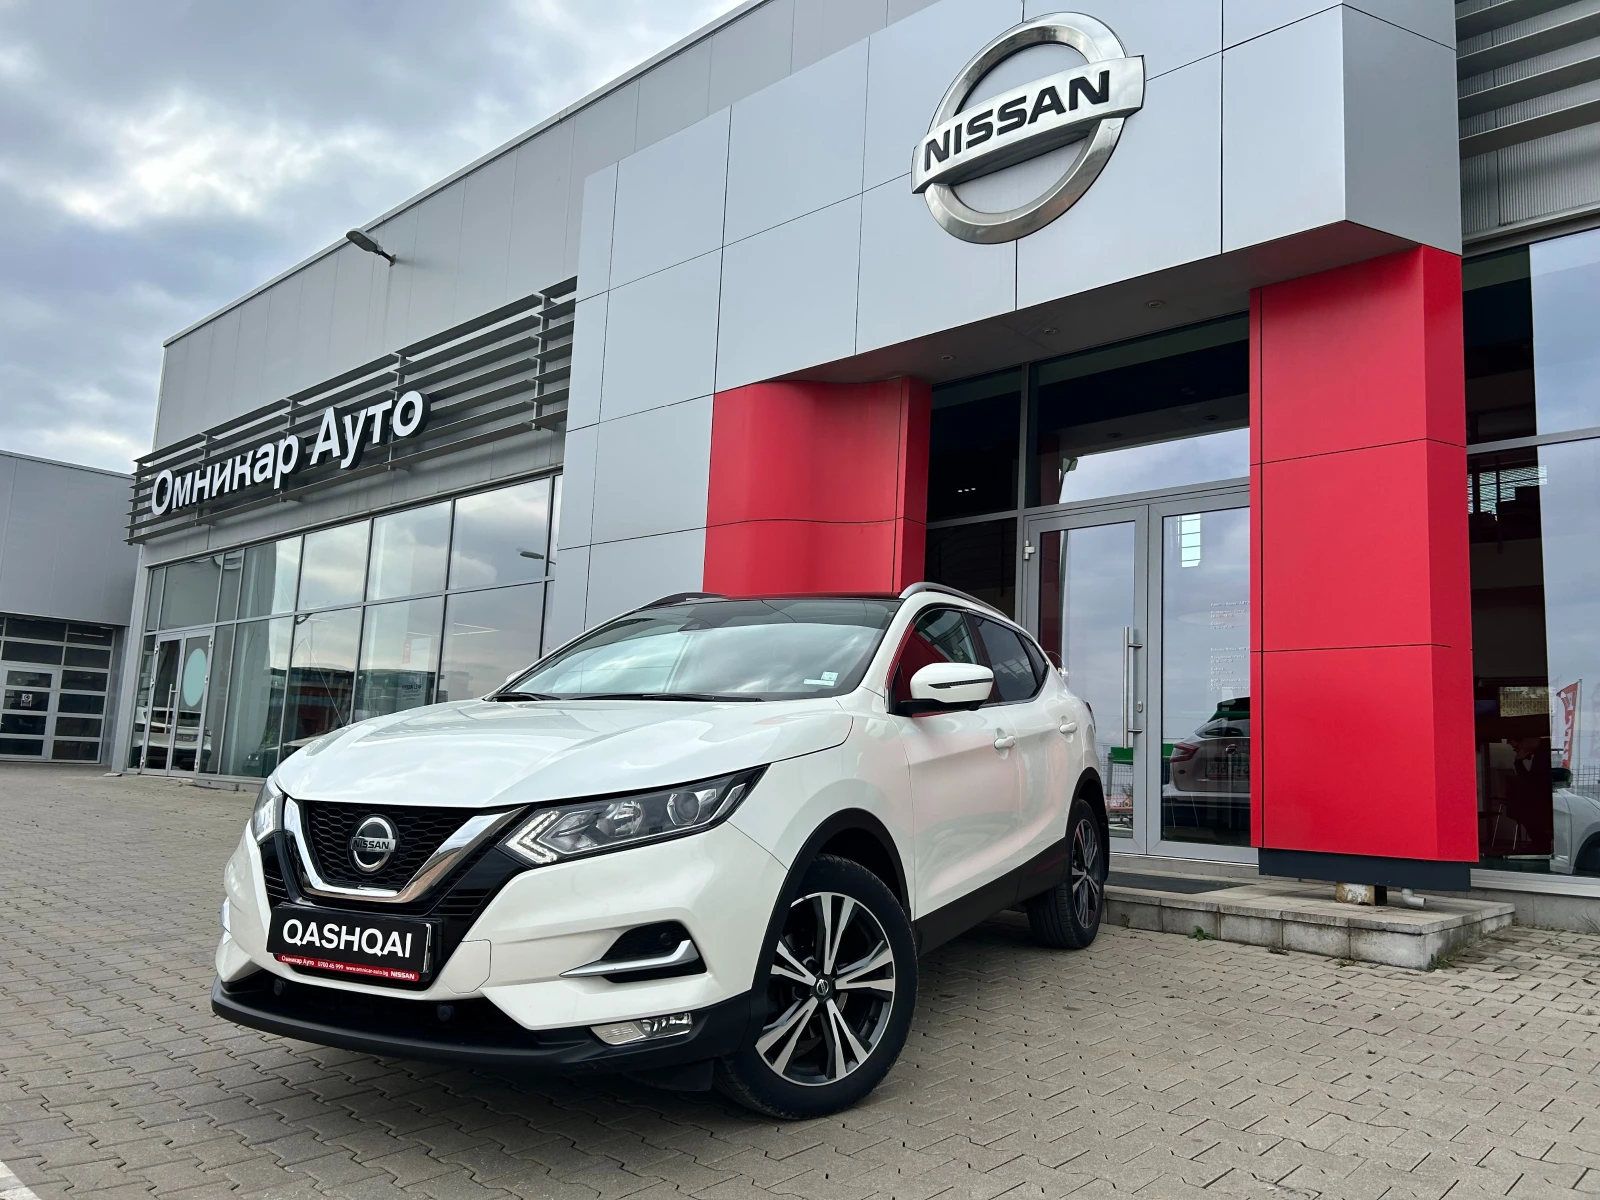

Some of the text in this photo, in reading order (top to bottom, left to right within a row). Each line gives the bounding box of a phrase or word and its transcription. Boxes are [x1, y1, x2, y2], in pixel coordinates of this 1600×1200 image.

[924, 70, 1110, 172] NISSAN
[151, 390, 424, 515] Омникар Ауто
[353, 840, 389, 849] NISSAN
[282, 919, 413, 958] QASHQAI
[317, 961, 329, 969] 0700
[390, 970, 415, 980] NISSAN
